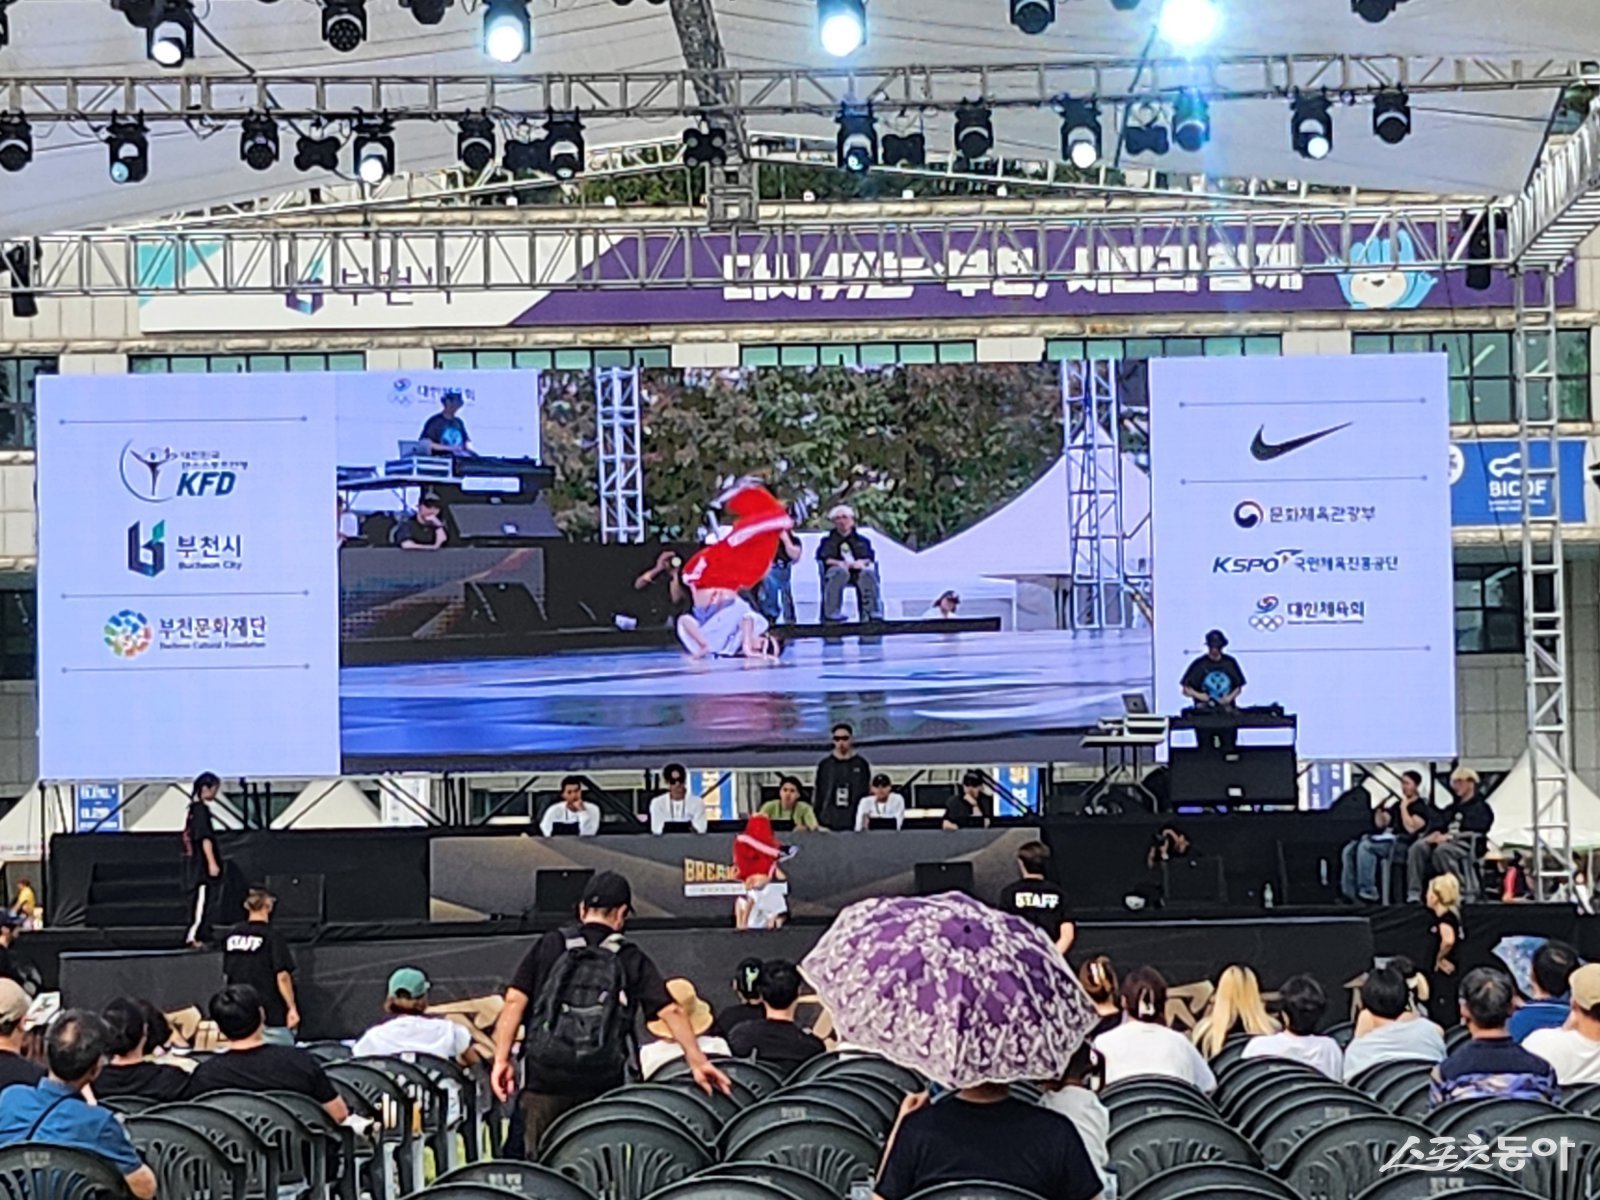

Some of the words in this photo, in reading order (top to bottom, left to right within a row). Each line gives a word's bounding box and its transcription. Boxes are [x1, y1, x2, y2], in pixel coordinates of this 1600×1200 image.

[176, 471, 236, 497] KFD
[1269, 506, 1376, 523] 문화체육관광부
[175, 534, 242, 558] 부천시
[1212, 556, 1279, 574] KSPO
[158, 616, 267, 640] 부천문화재단
[1015, 891, 1060, 908] STAFF
